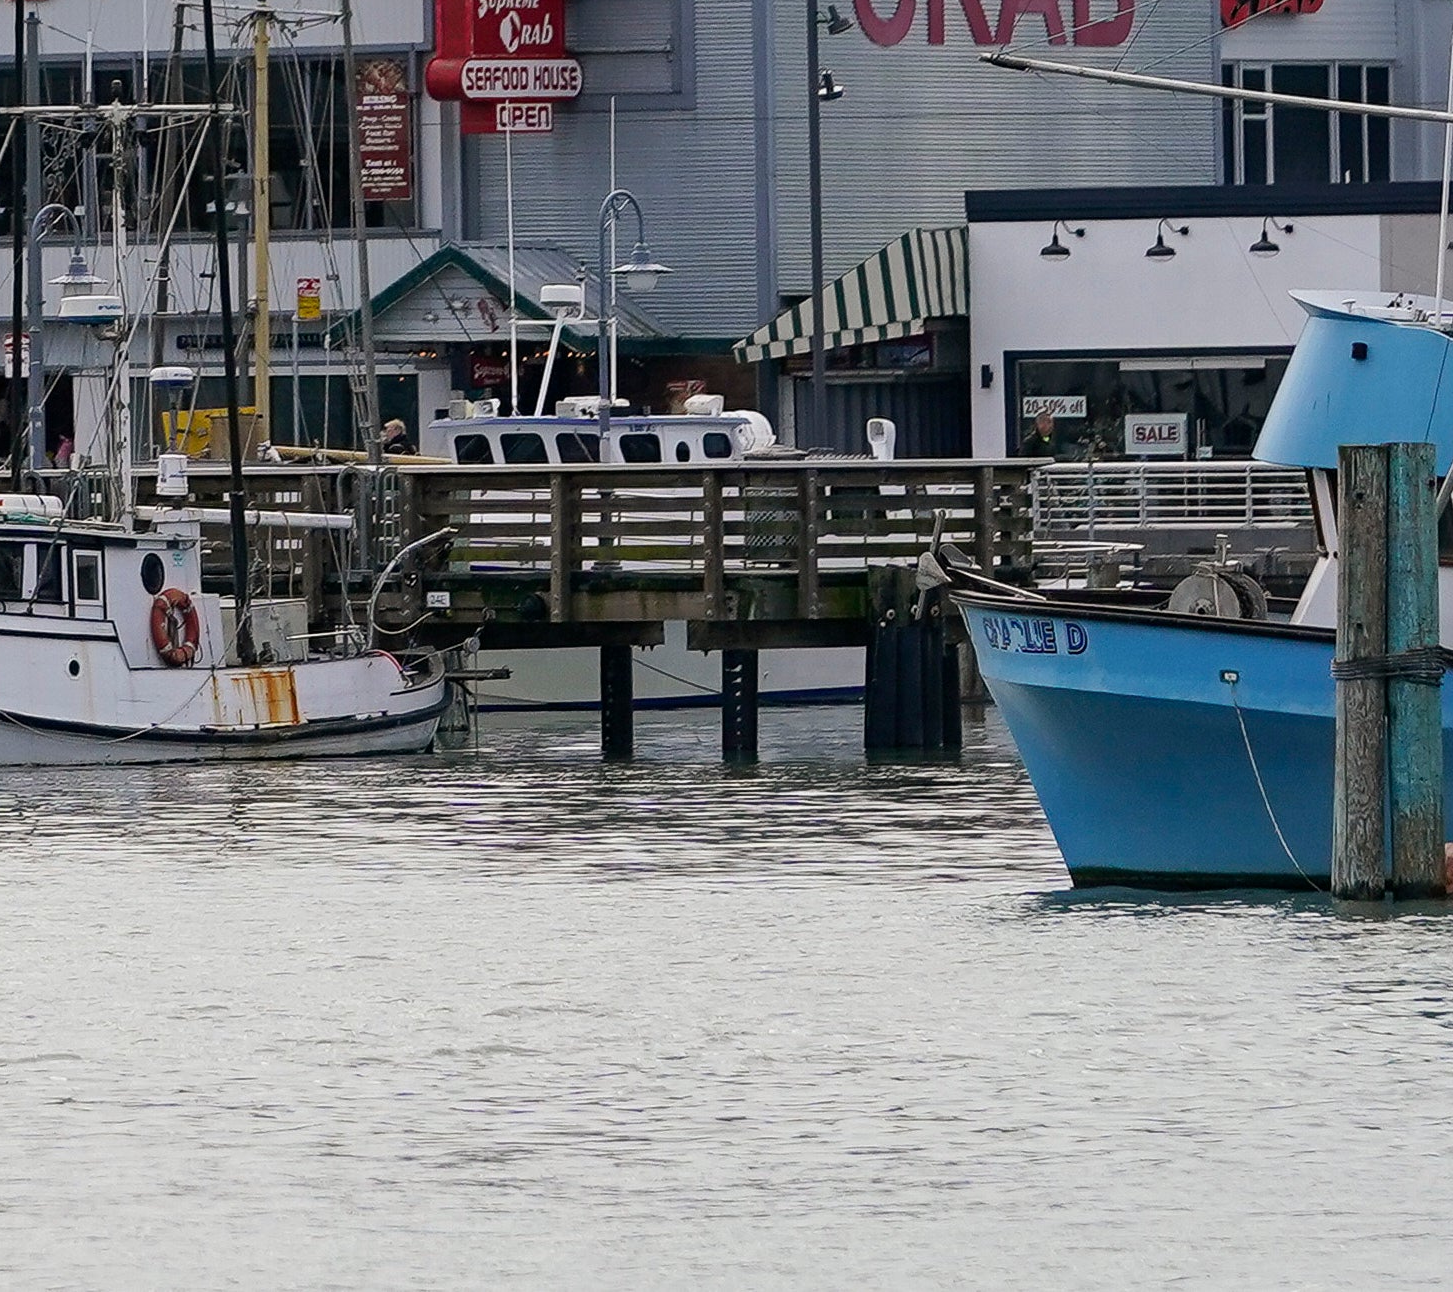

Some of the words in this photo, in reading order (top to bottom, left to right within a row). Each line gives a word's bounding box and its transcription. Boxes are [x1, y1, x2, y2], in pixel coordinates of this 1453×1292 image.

[465, 66, 529, 91] SEAFOOD
[533, 66, 579, 91] HOUSE
[499, 105, 550, 128] OPEN
[1135, 425, 1178, 442] SALE
[1063, 619, 1088, 655] D
